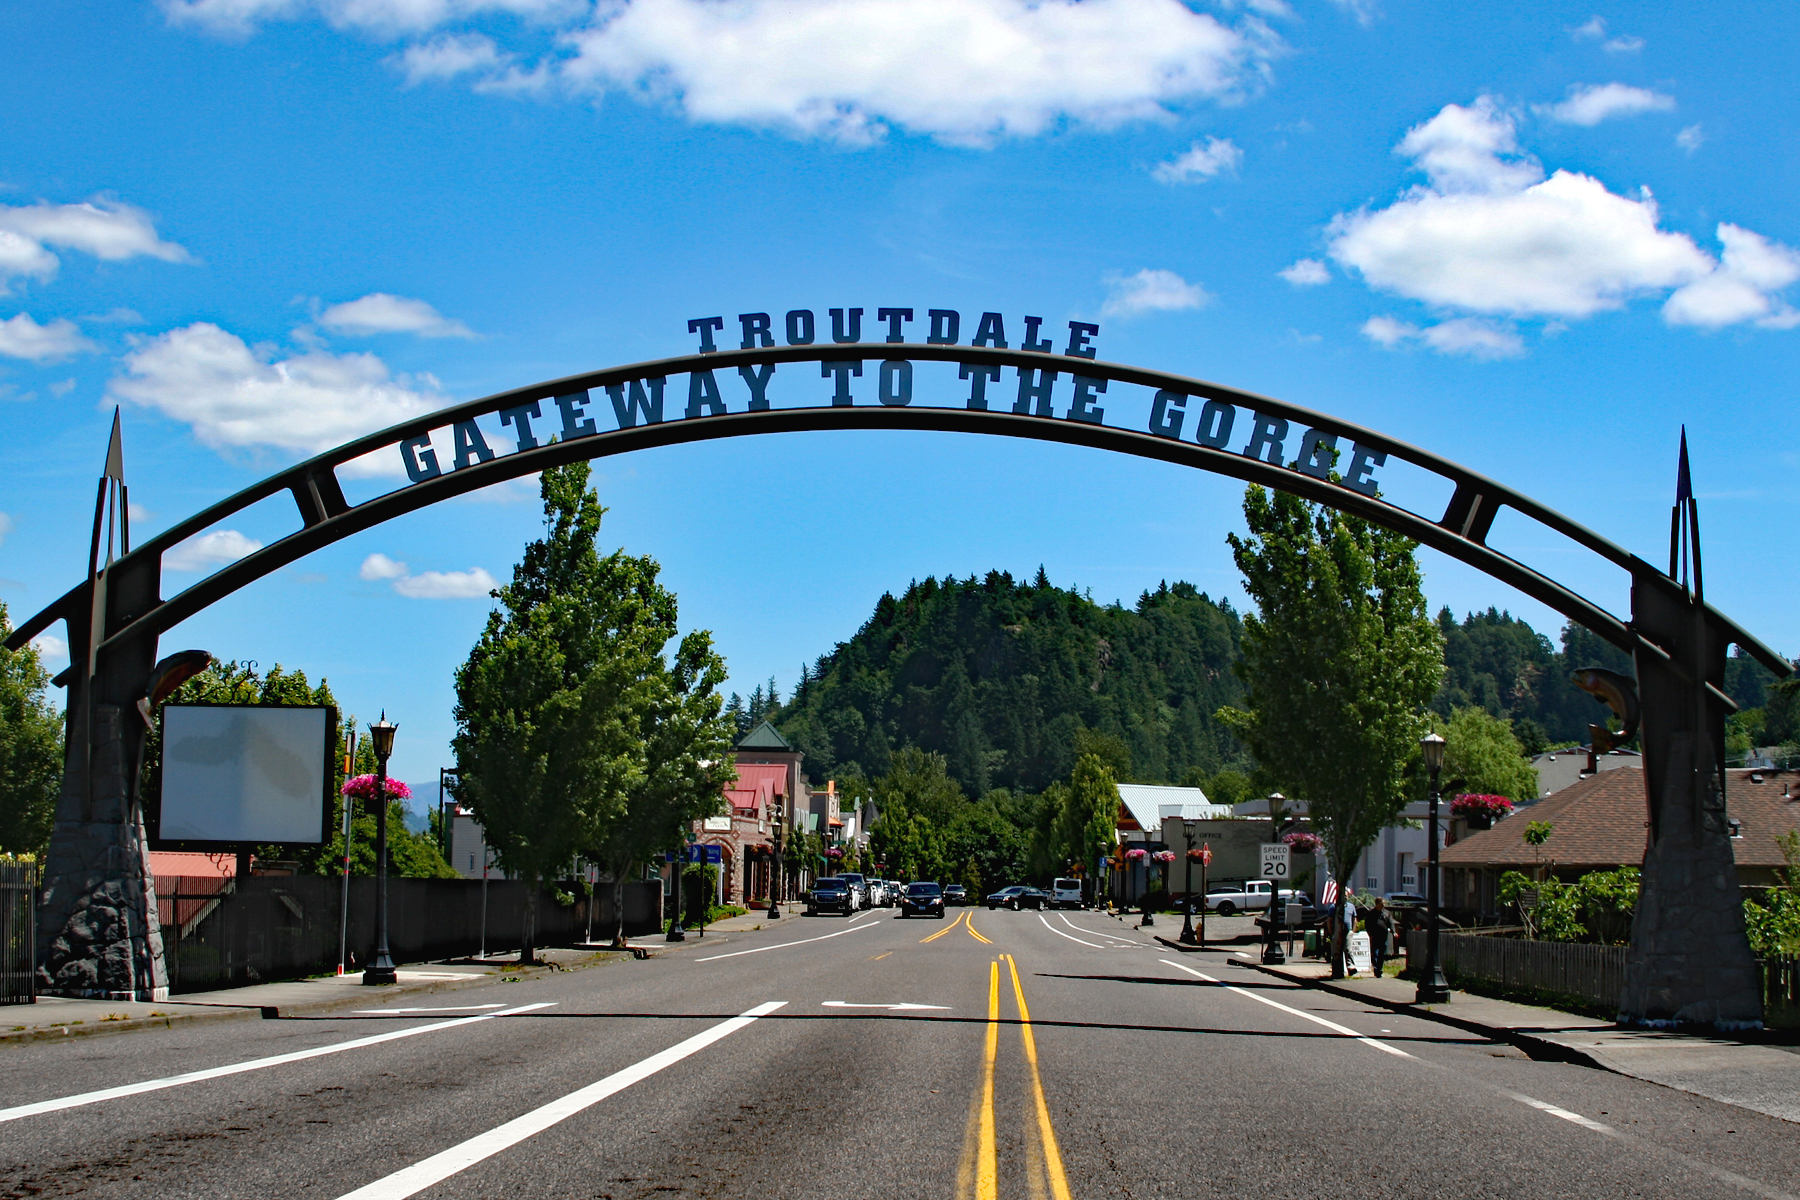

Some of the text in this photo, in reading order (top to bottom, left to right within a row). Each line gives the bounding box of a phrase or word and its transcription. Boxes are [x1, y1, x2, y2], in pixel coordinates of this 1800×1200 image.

[688, 308, 1099, 359] TROUTDALE
[400, 359, 1388, 497] GATEWAY TO THE GORGE
[1263, 862, 1287, 876] 20
